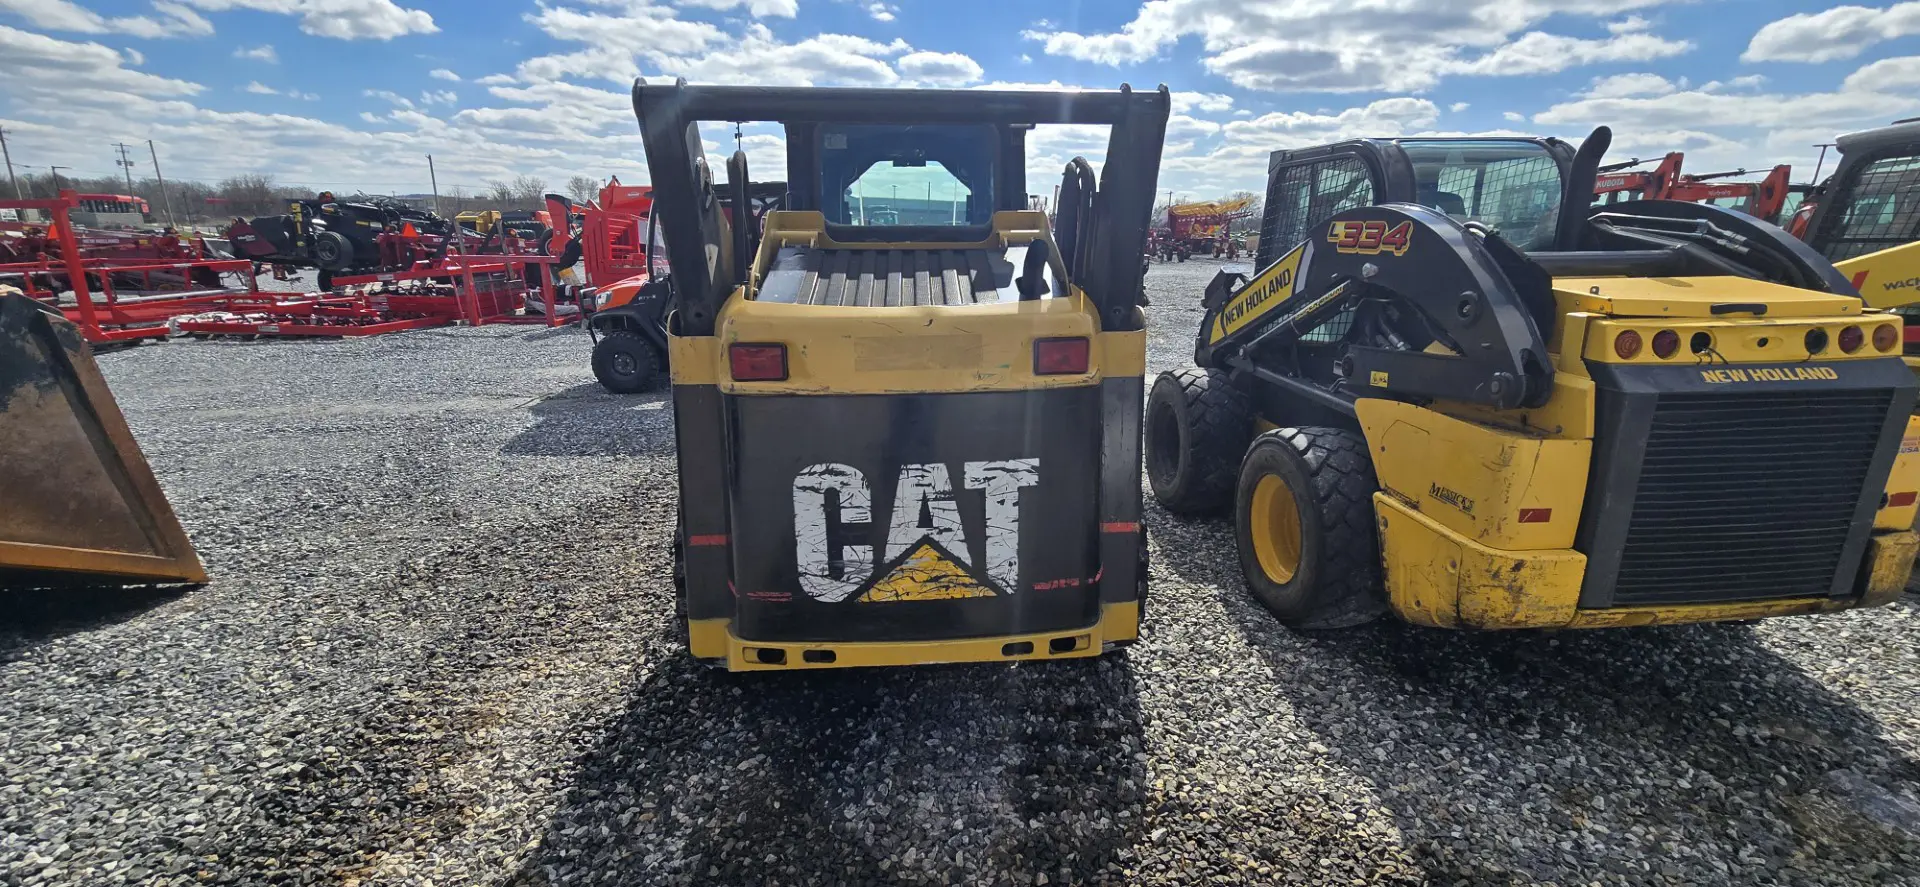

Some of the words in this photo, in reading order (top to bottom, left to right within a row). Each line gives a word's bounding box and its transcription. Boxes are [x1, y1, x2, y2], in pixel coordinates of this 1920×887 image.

[1596, 178, 1625, 188] KUBOTA
[1327, 221, 1413, 256] L334
[1224, 301, 1244, 326] NEW
[1245, 268, 1291, 314] HOLLAND
[1701, 369, 1749, 383] NEW
[1747, 367, 1838, 381] HOLLAND
[792, 457, 1040, 603] CAT
